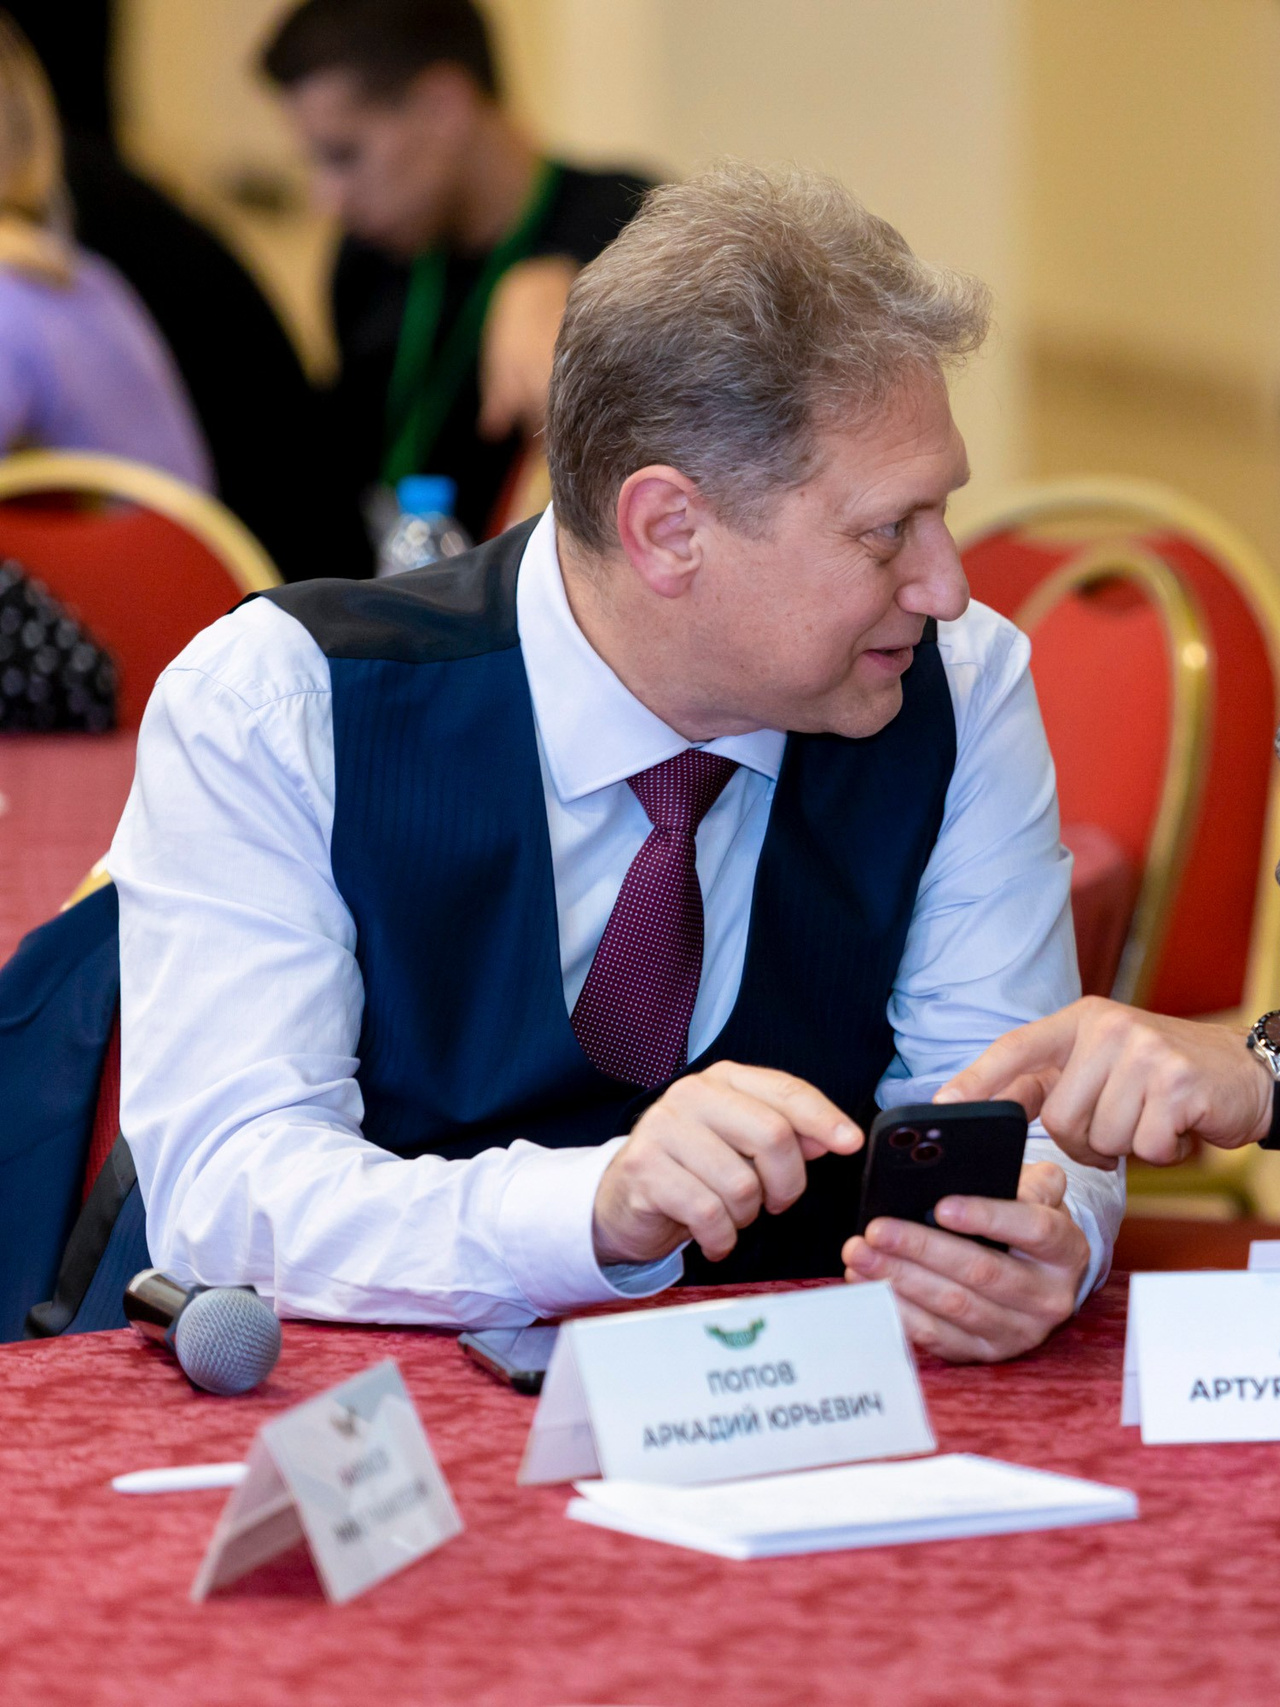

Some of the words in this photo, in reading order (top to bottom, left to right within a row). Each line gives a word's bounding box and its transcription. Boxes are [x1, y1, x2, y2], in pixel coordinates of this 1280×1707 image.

[707, 1361, 796, 1394] ПОПОВ
[643, 1404, 760, 1450] АРКАДИЙ
[768, 1393, 885, 1431] ЮРЬЕВИЧ
